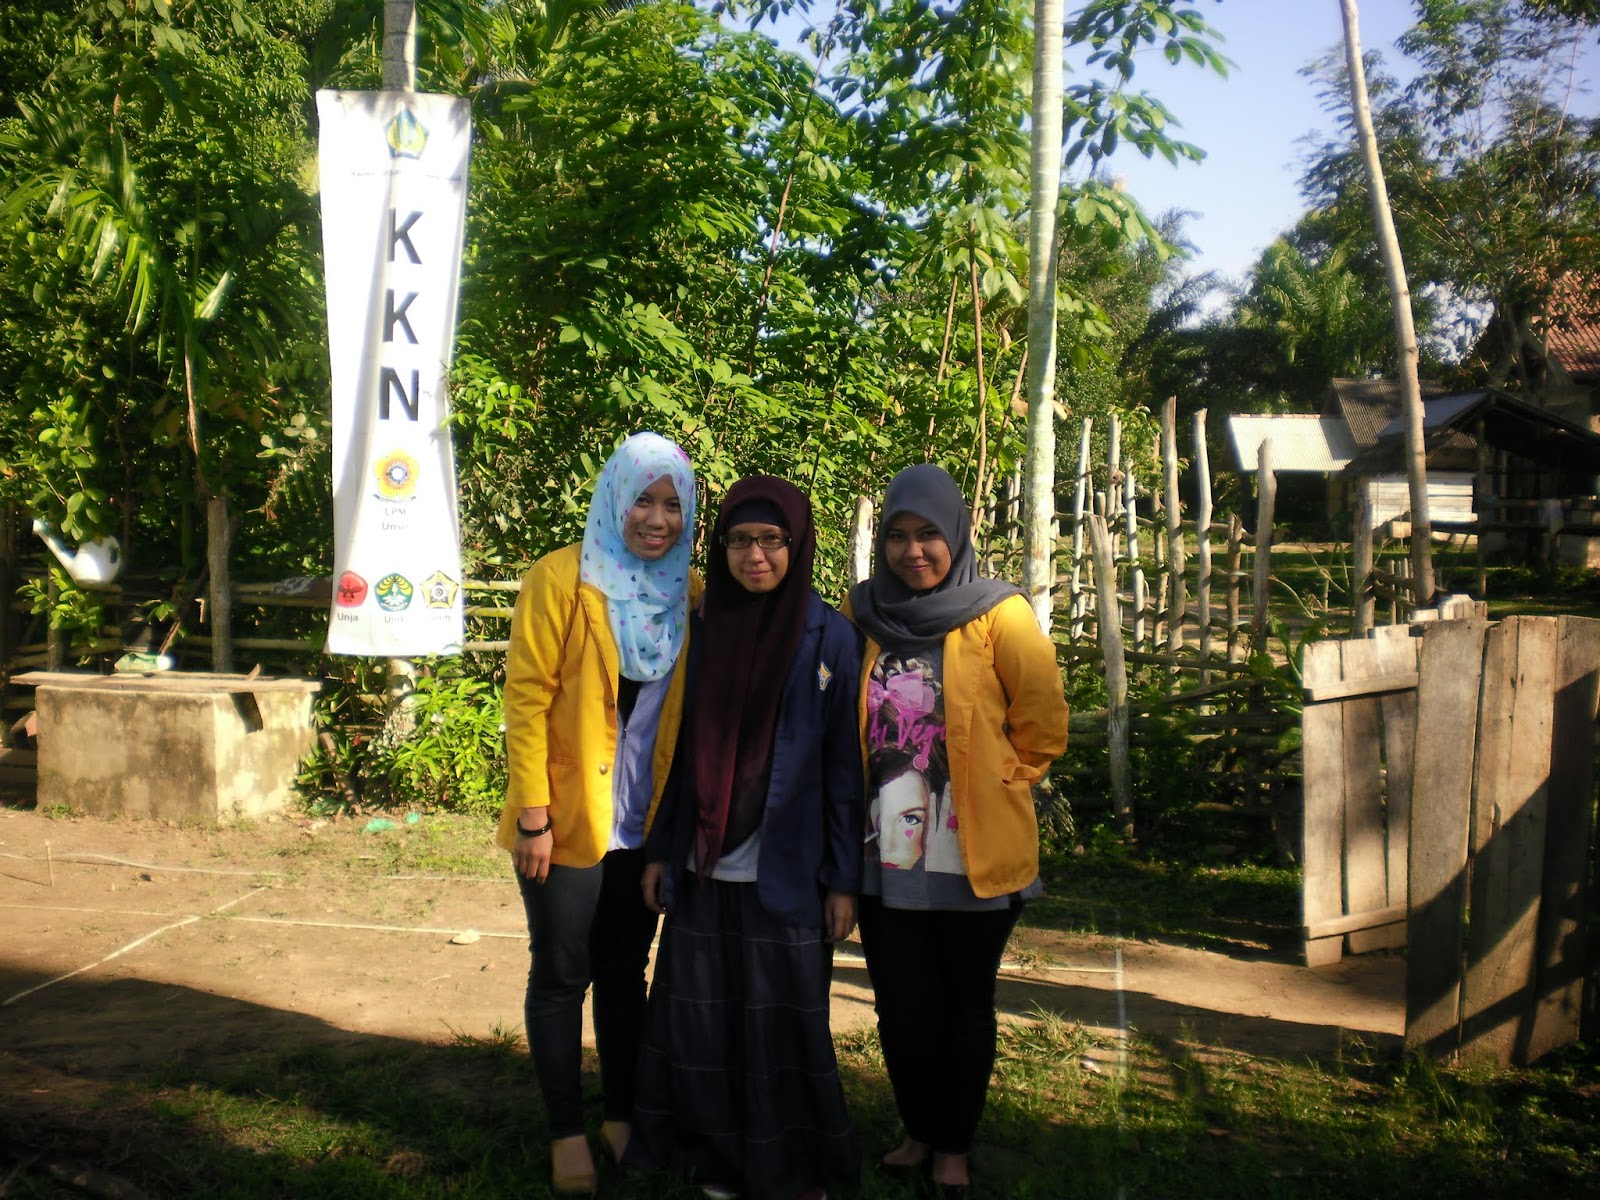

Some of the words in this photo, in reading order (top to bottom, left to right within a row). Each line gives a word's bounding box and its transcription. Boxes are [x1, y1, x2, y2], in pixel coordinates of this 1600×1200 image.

[379, 208, 424, 422] KKN
[384, 507, 407, 516] LPM
[336, 612, 359, 623] Unja
